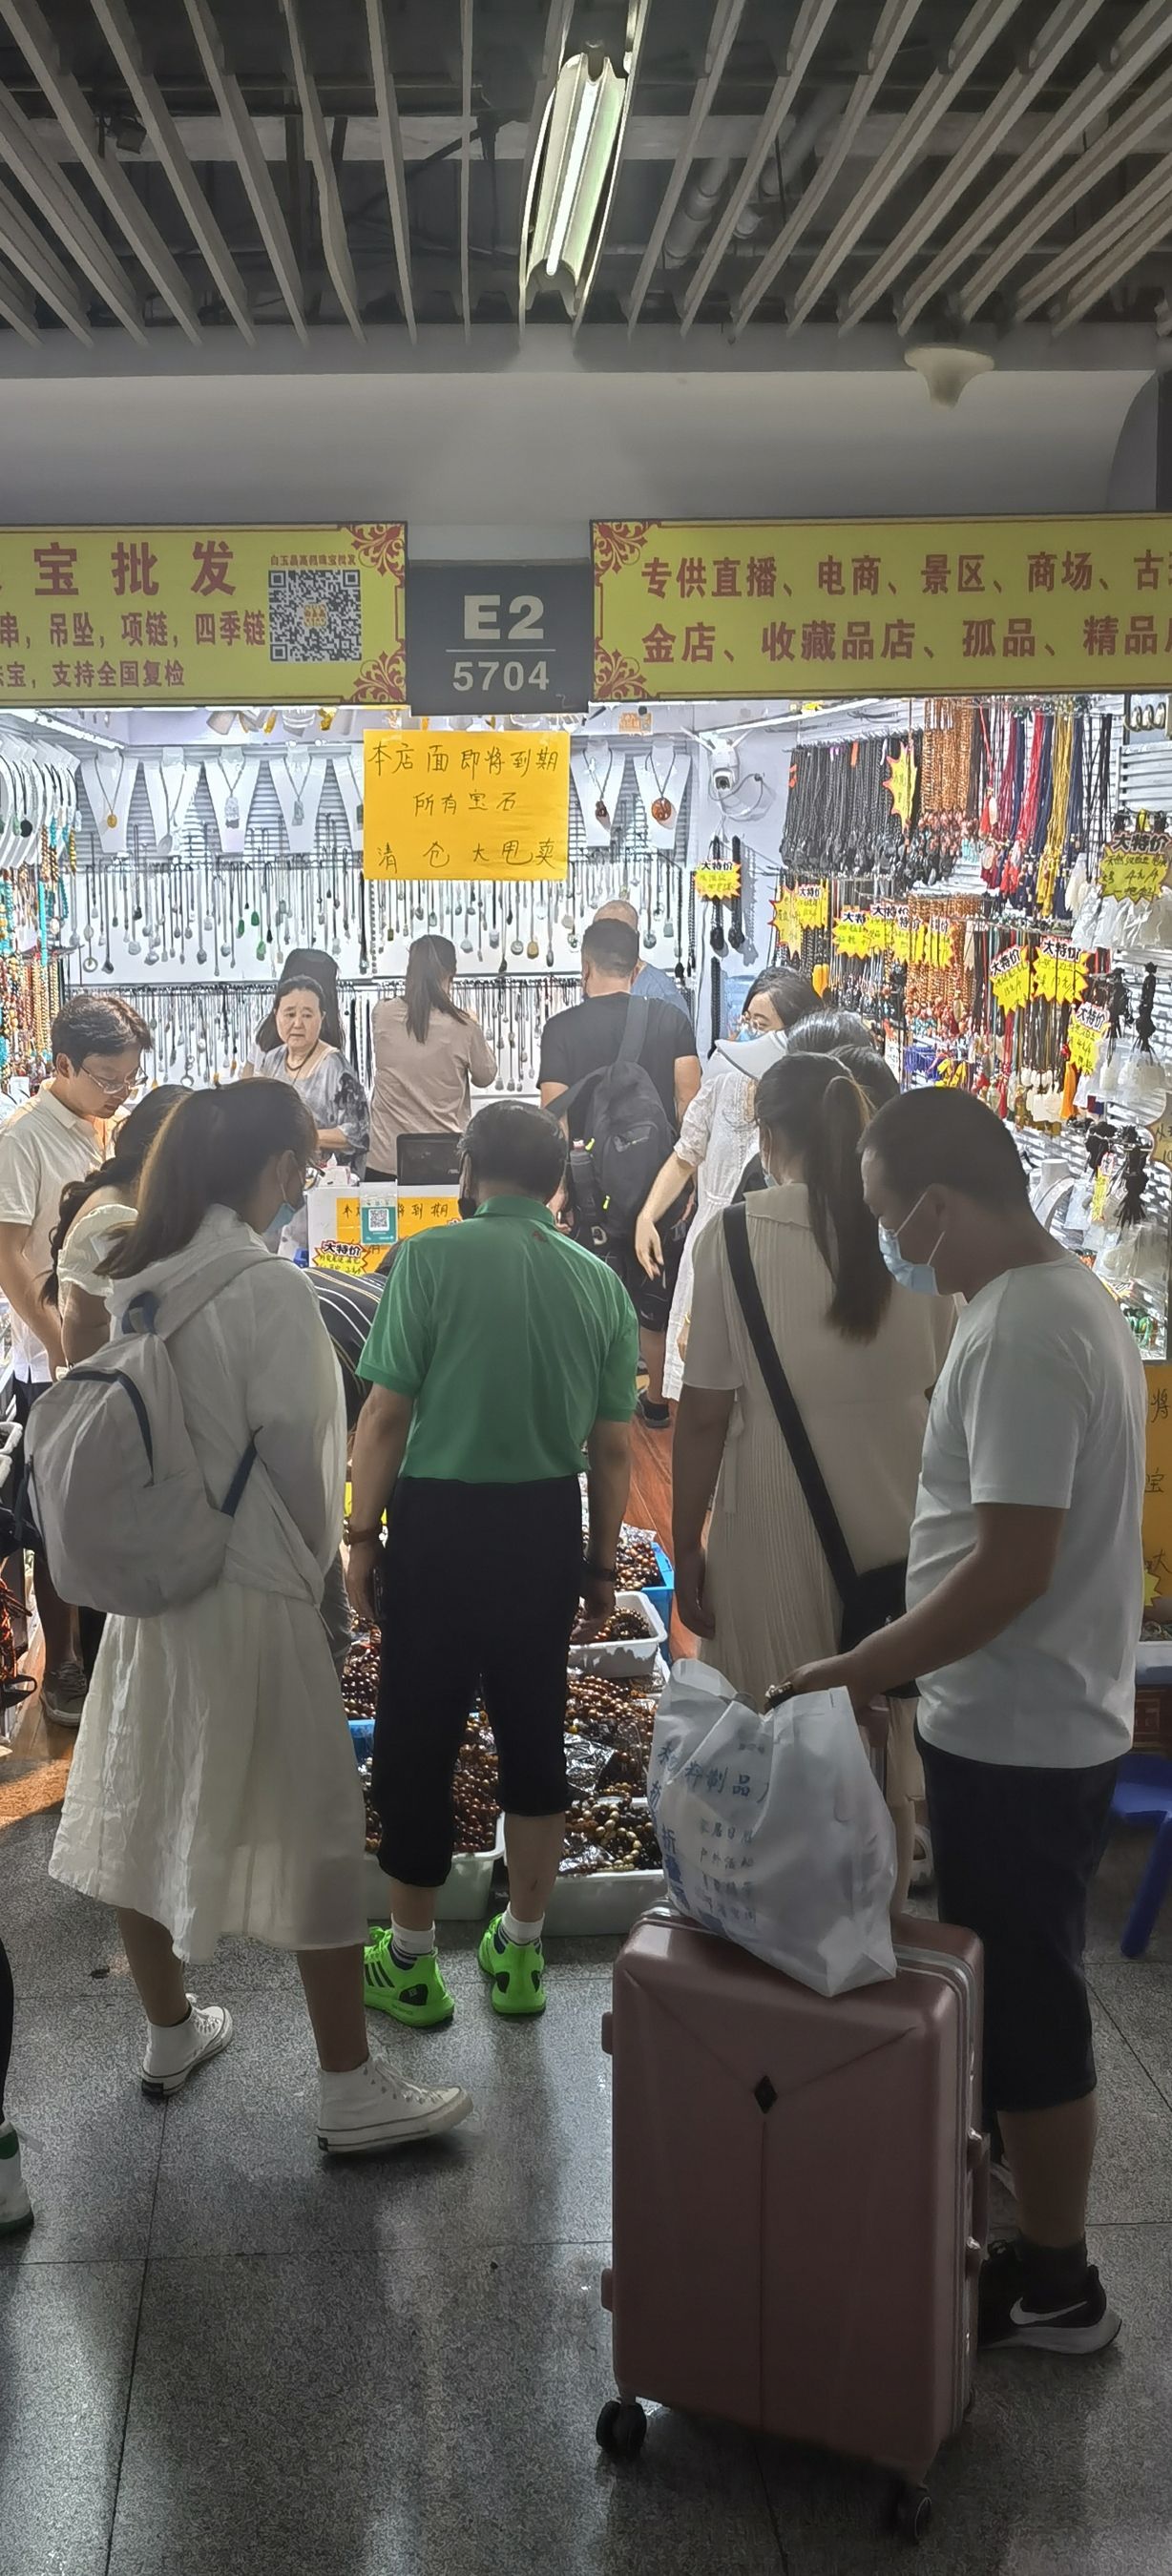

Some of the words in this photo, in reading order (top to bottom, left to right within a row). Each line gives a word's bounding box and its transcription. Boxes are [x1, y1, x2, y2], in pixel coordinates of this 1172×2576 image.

[641, 550, 1172, 598] 专供直播、电商、景区、商场、古
[464, 594, 544, 640] E2
[641, 615, 1172, 663] 金店、收藏品店、孤品、精品
[0, 659, 185, 688] 宝，支持全国复检
[452, 660, 550, 692] 5704
[366, 740, 558, 779] 本店面即将到期
[412, 789, 517, 818] 所有宝石
[377, 837, 555, 873] 清仓大甩卖
[1112, 832, 1169, 852] 大特价
[843, 911, 867, 924] 大特
[992, 948, 1020, 977] 大特价
[1043, 941, 1081, 960] 大特价
[1078, 1008, 1106, 1030] 大特价
[324, 1242, 362, 1257] 大特价
